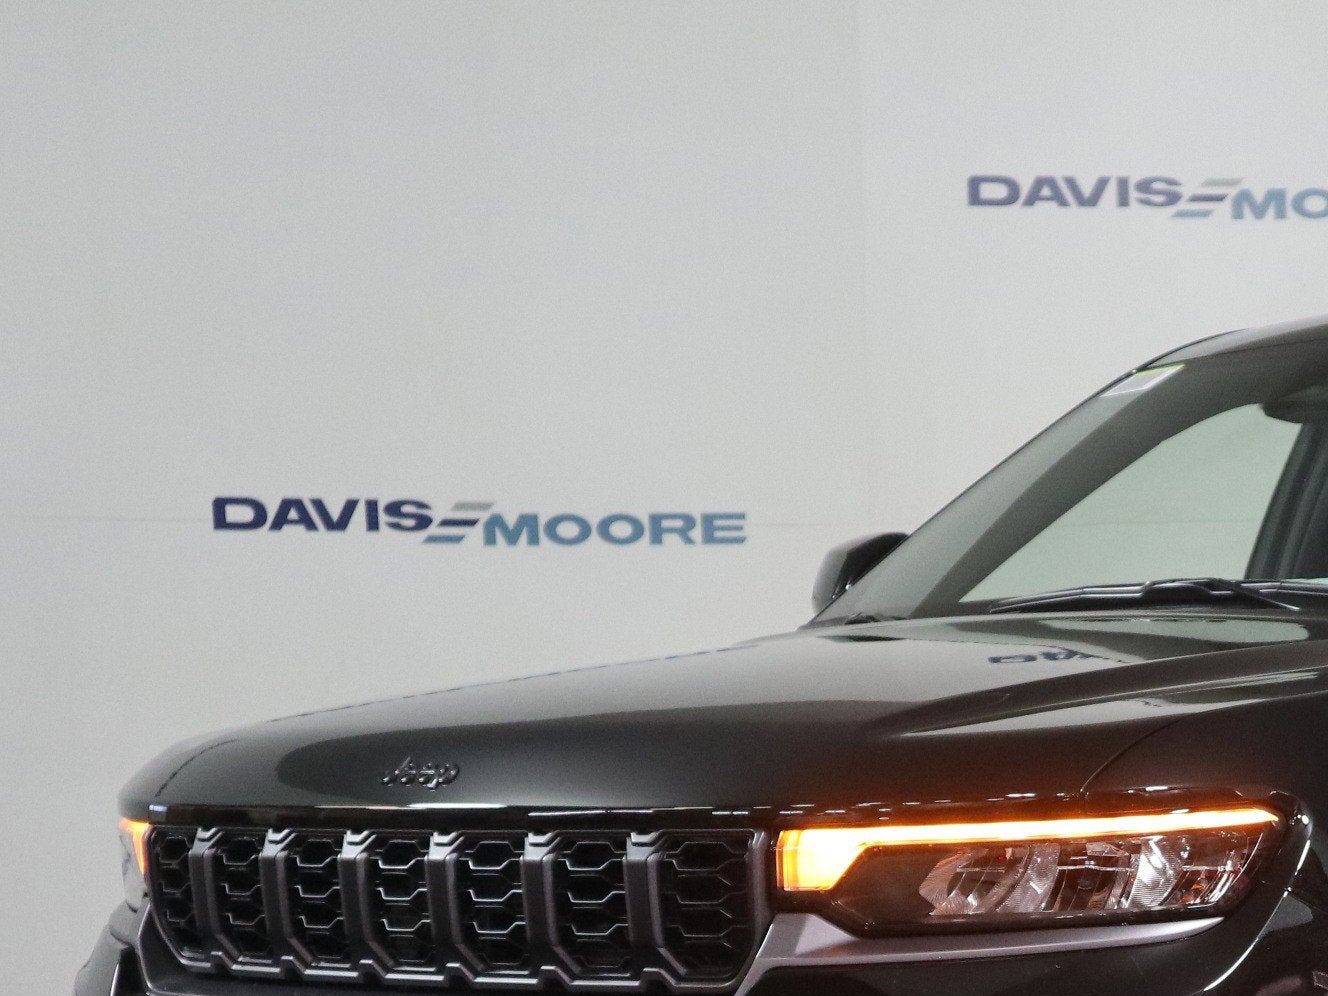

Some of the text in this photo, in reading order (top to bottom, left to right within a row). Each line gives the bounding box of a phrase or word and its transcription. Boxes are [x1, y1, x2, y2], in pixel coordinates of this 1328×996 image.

[966, 175, 1183, 208] DAVIS
[212, 497, 746, 546] DAVIS MOORE
